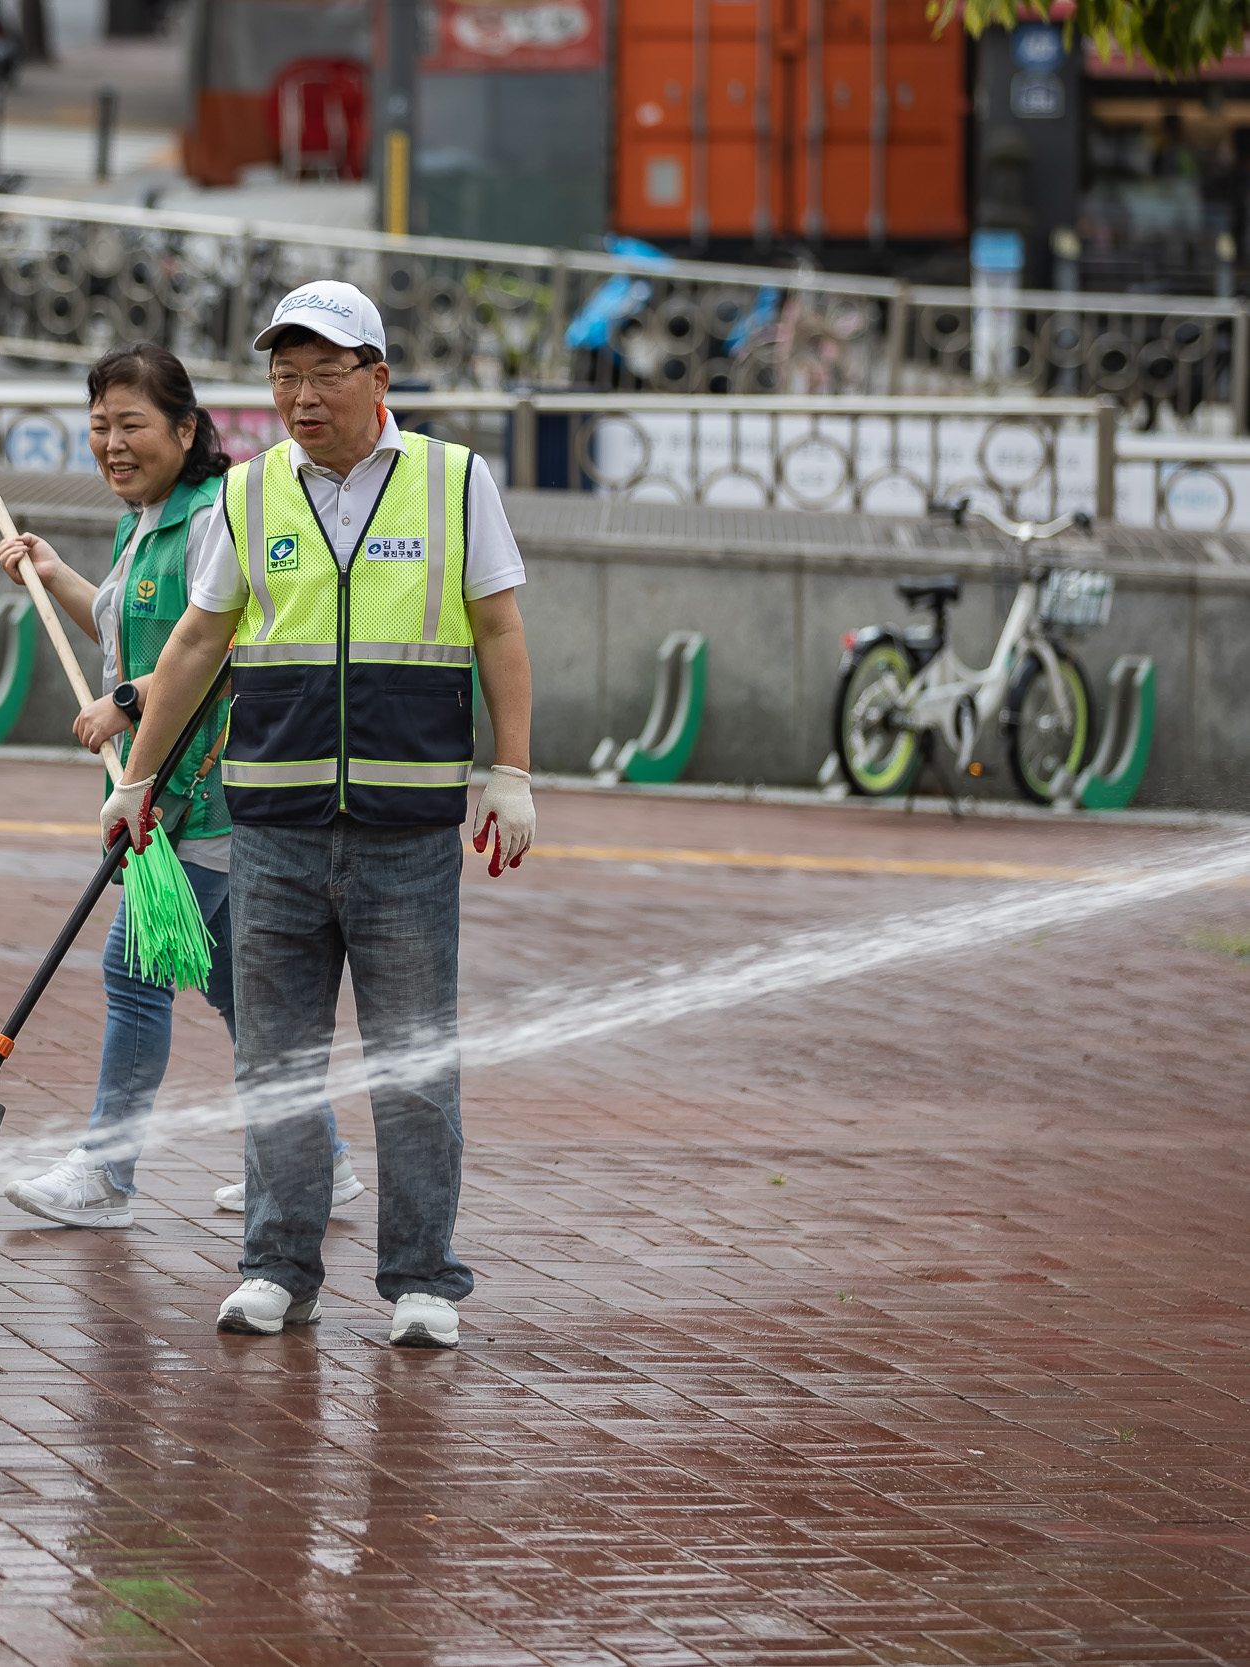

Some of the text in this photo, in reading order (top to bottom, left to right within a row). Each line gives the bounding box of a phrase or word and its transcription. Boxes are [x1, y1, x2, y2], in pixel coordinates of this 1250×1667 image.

[275, 292, 354, 322] Titleist
[383, 550, 422, 558] 광진구청장
[270, 559, 295, 568] 광진구
